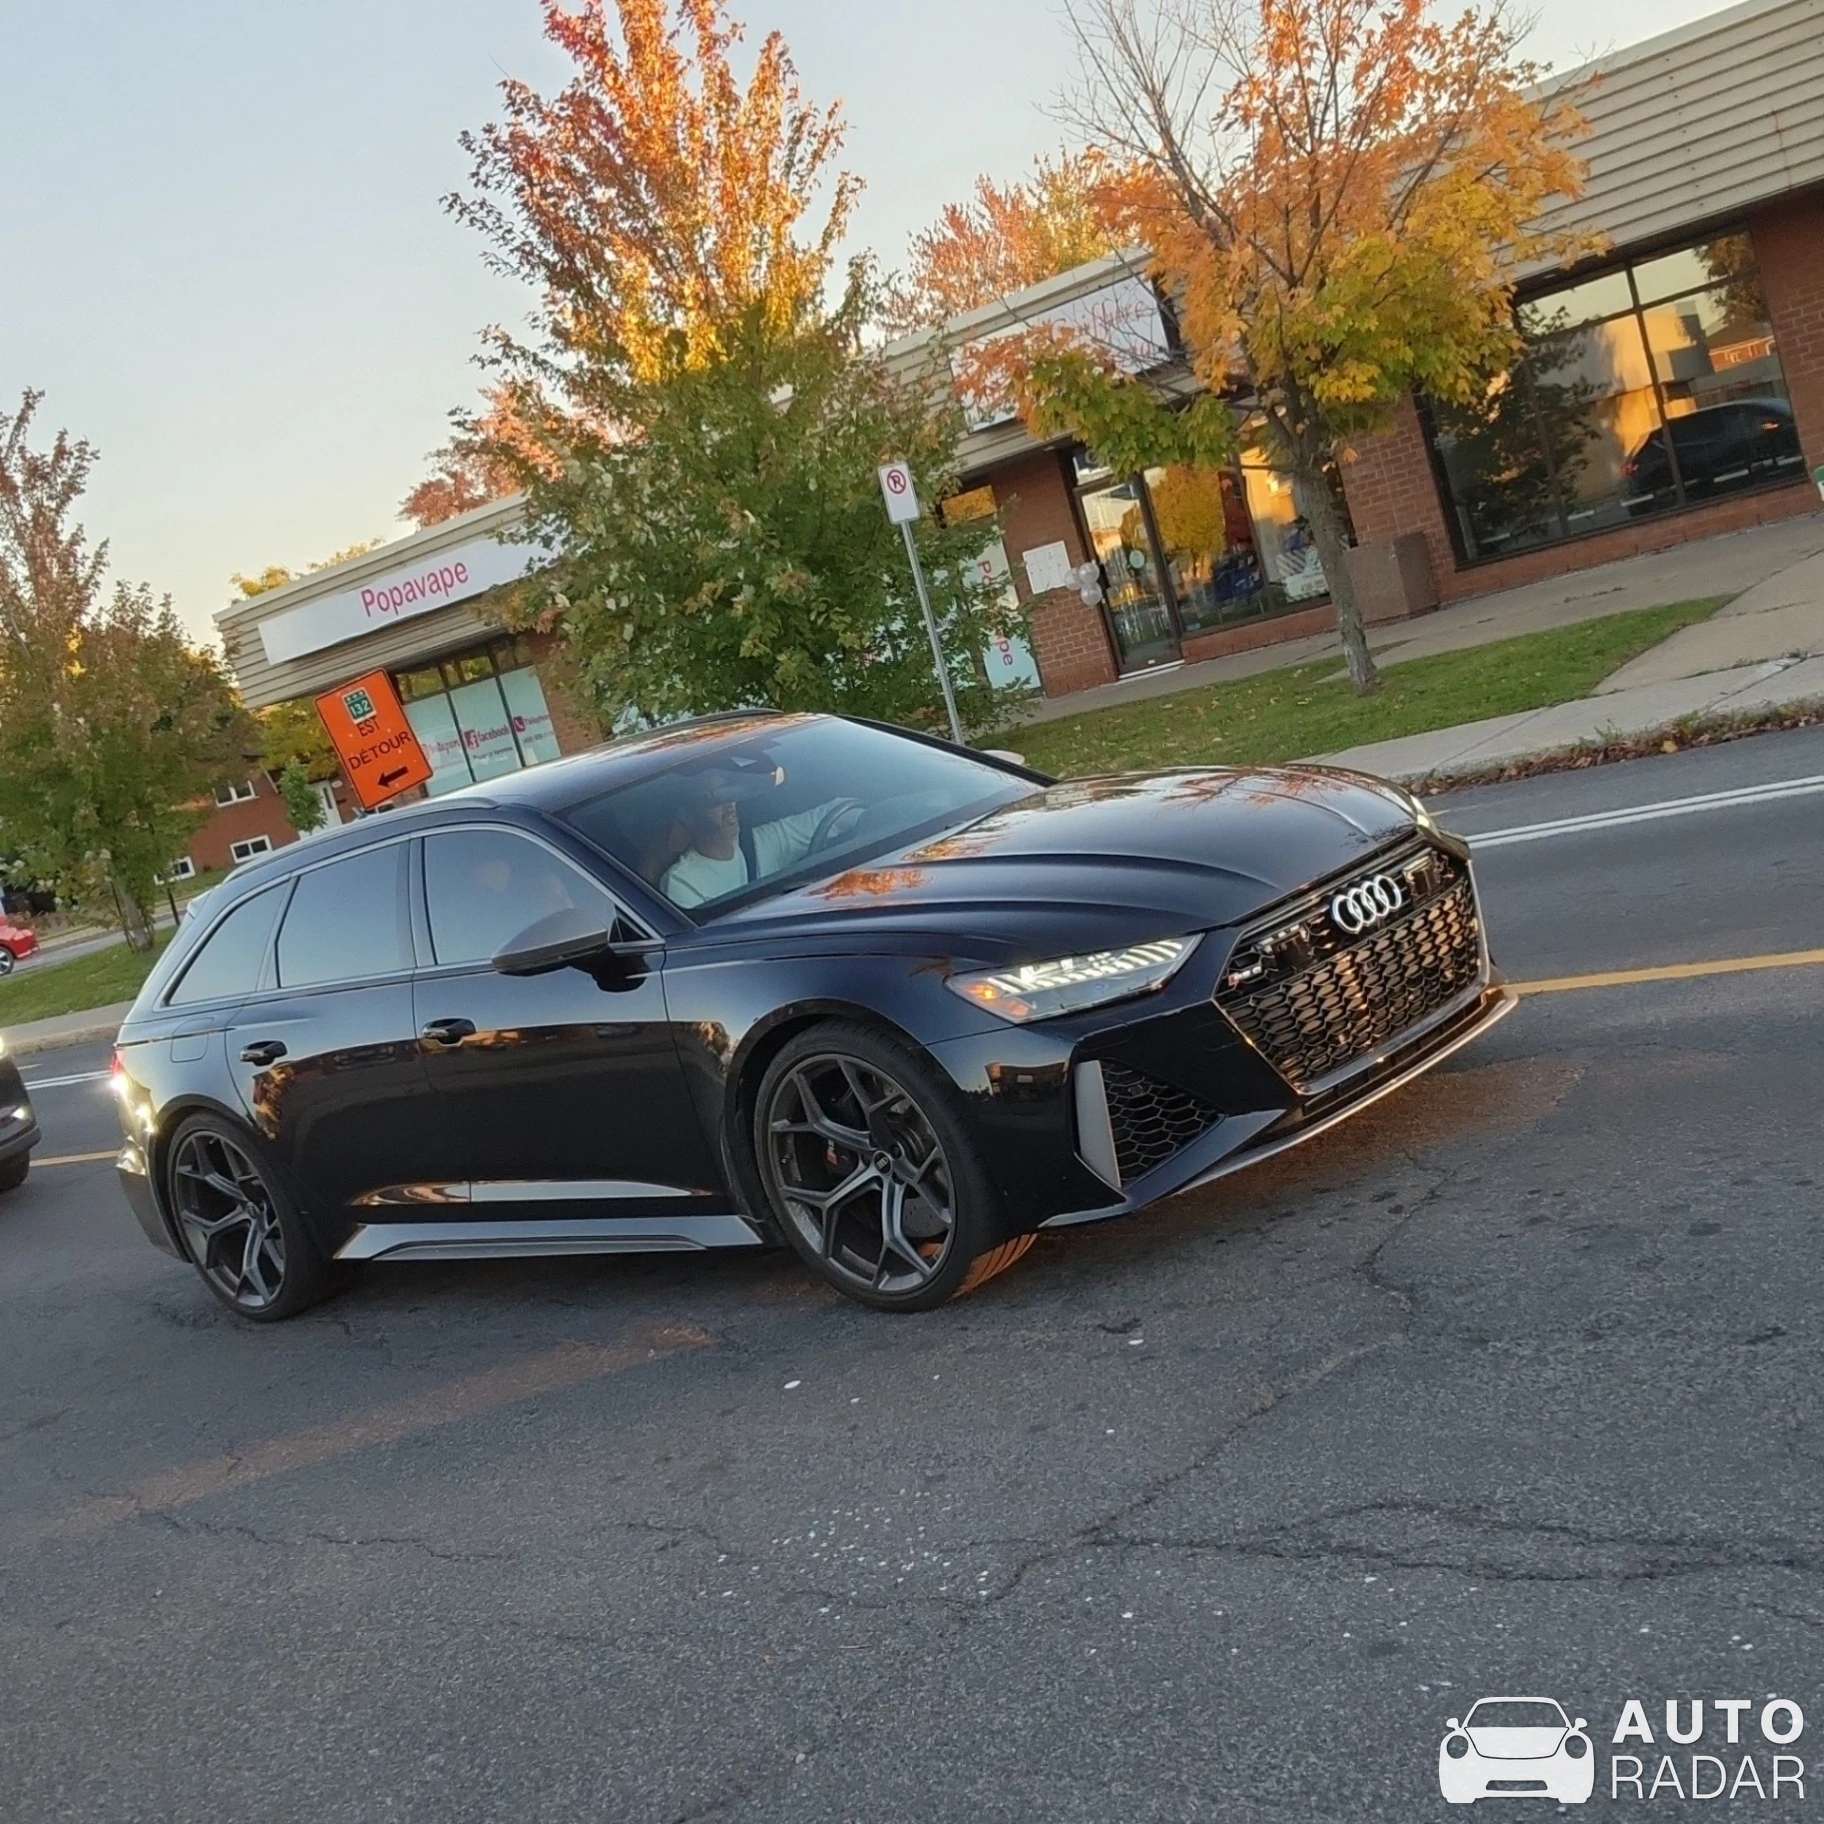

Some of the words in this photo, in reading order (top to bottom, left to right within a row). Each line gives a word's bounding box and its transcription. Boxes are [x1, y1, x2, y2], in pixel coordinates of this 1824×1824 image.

[361, 562, 469, 617] Popavape
[350, 700, 371, 717] 132
[357, 715, 380, 737] EST
[348, 731, 411, 770] DÉTOUR
